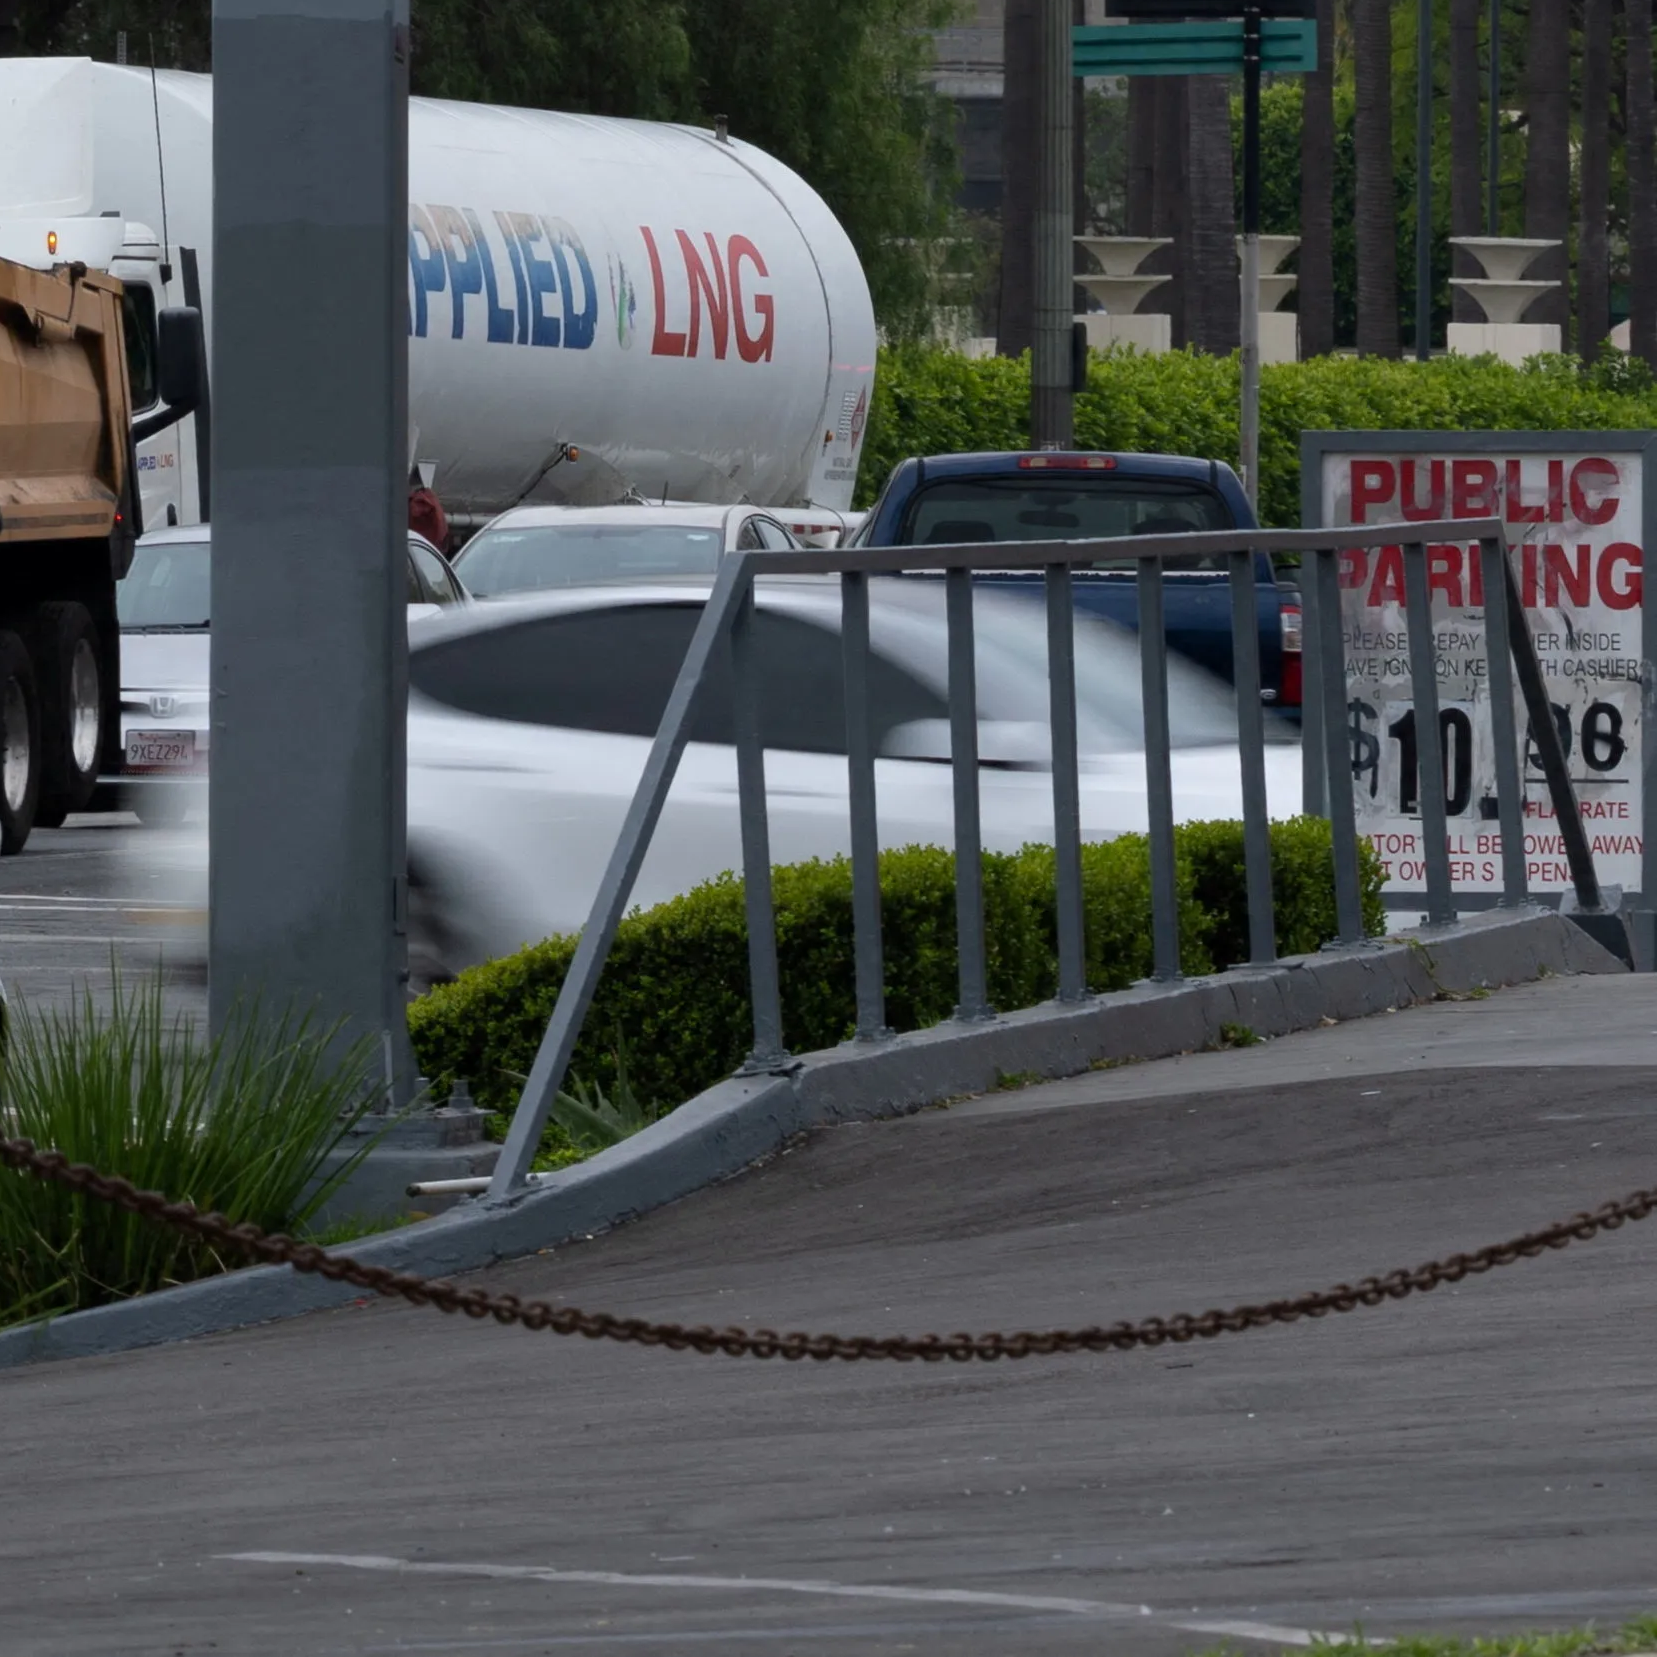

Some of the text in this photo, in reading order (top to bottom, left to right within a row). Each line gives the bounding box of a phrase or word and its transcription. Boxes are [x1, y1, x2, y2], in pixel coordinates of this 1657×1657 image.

[639, 226, 774, 363] LNG
[1349, 457, 1620, 525] PUBLIC
[1338, 542, 1645, 611] PARING
[1342, 632, 1408, 652] PLEASE
[1566, 632, 1621, 652] INSIDE
[1526, 802, 1629, 819] FLA RATE
[1592, 834, 1644, 855] AWAY
[1399, 861, 1475, 881] OWER
